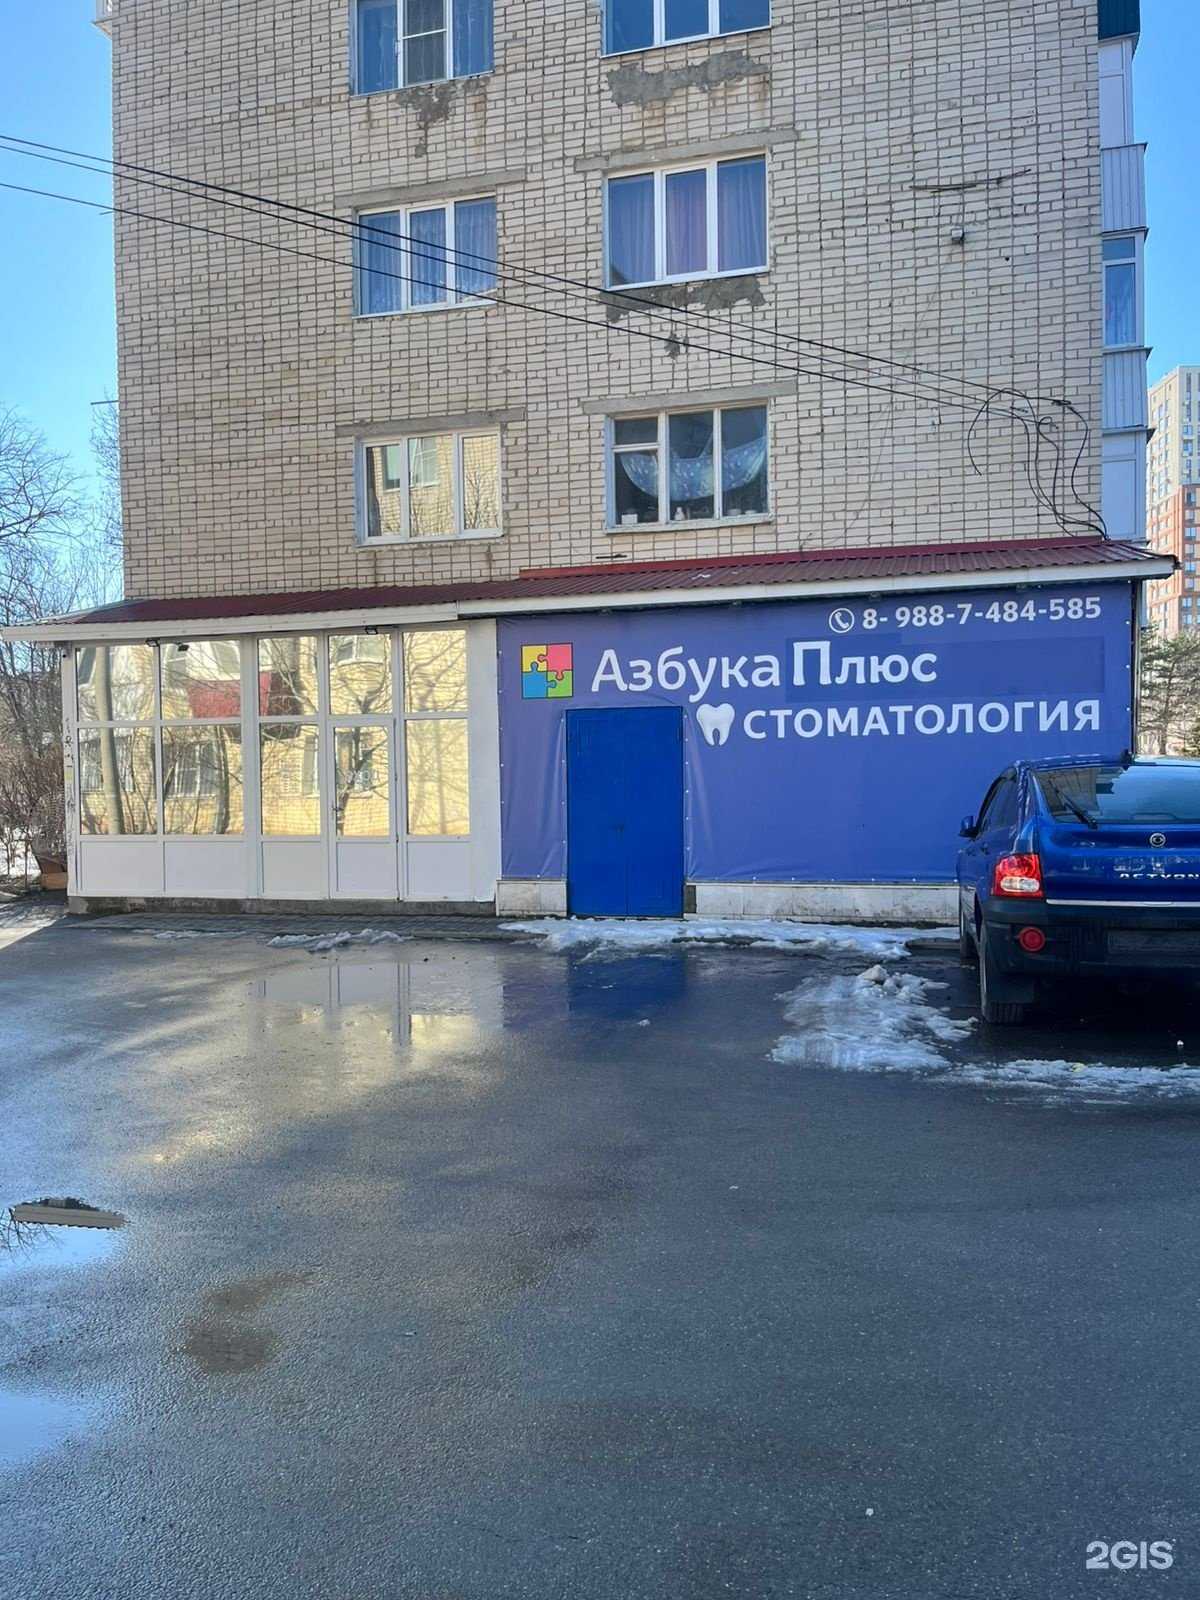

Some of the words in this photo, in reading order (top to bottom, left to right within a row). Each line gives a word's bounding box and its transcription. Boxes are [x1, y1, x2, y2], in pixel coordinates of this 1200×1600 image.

[895, 597, 1101, 628] 988-7-484-585
[591, 646, 780, 703] Азбука
[792, 640, 937, 685] Плюс
[743, 699, 1100, 739] СТОМАТОЛОГИЯ
